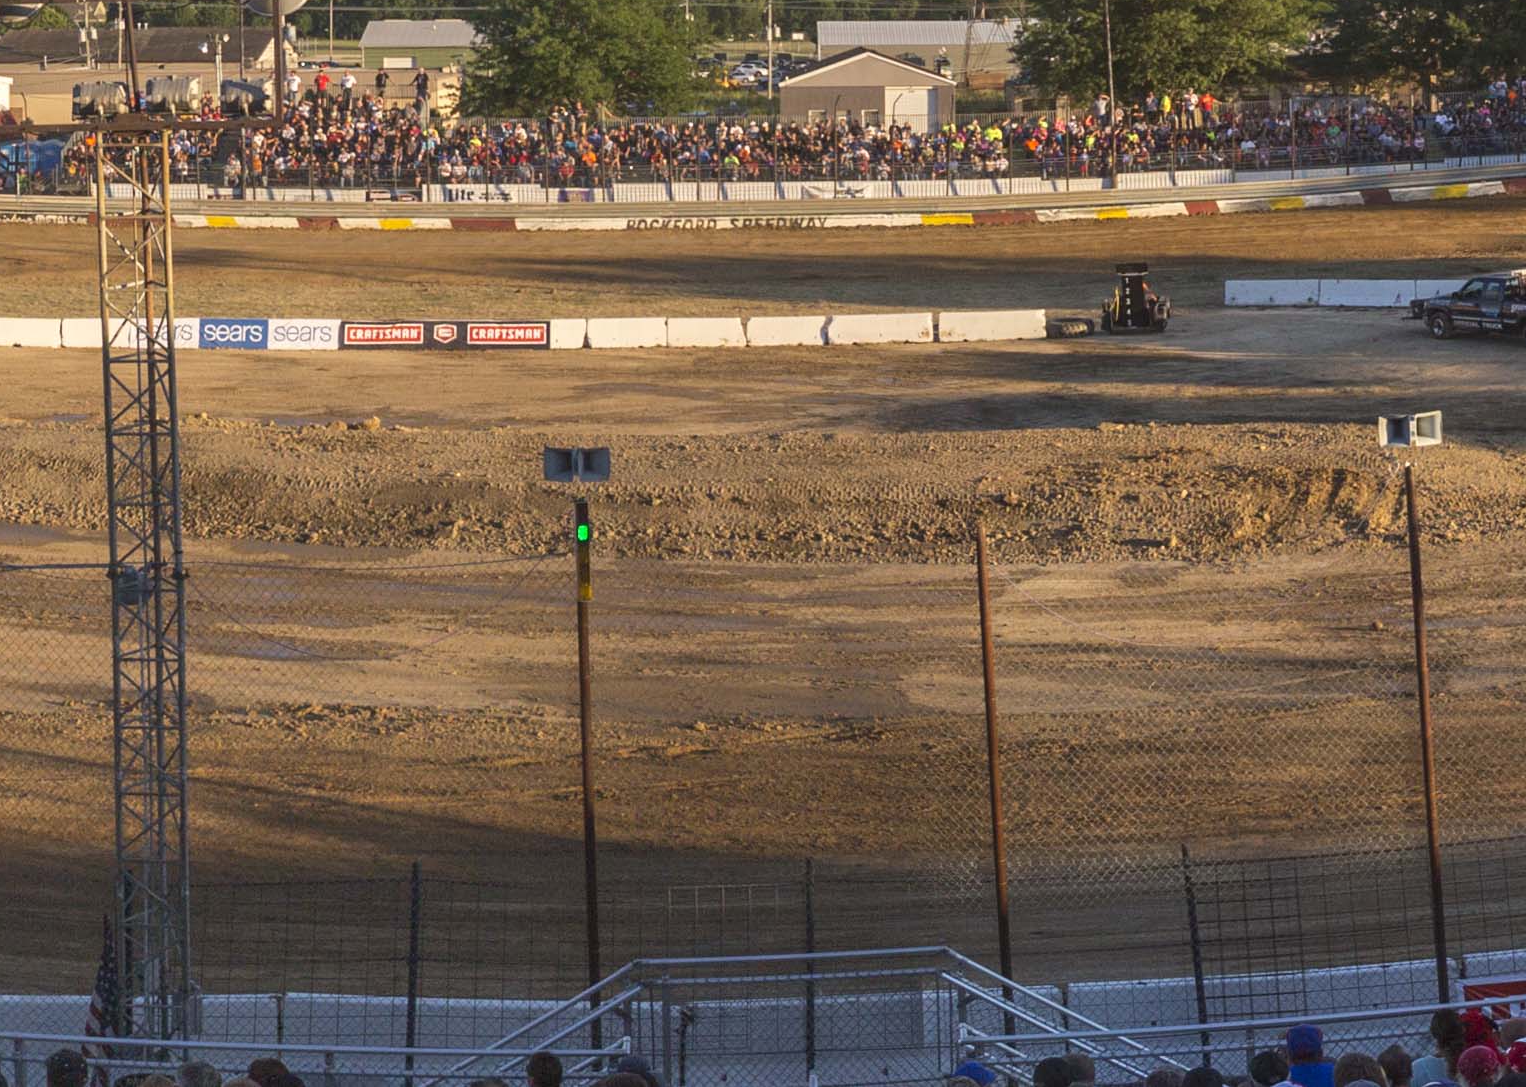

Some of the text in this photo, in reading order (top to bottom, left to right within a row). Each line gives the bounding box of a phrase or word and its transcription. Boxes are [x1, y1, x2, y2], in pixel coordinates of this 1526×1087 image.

[203, 324, 263, 342] sears
[273, 324, 333, 342] sears
[349, 328, 419, 340] CRAFTSMAN
[471, 327, 542, 340] CRAFTSMAN
